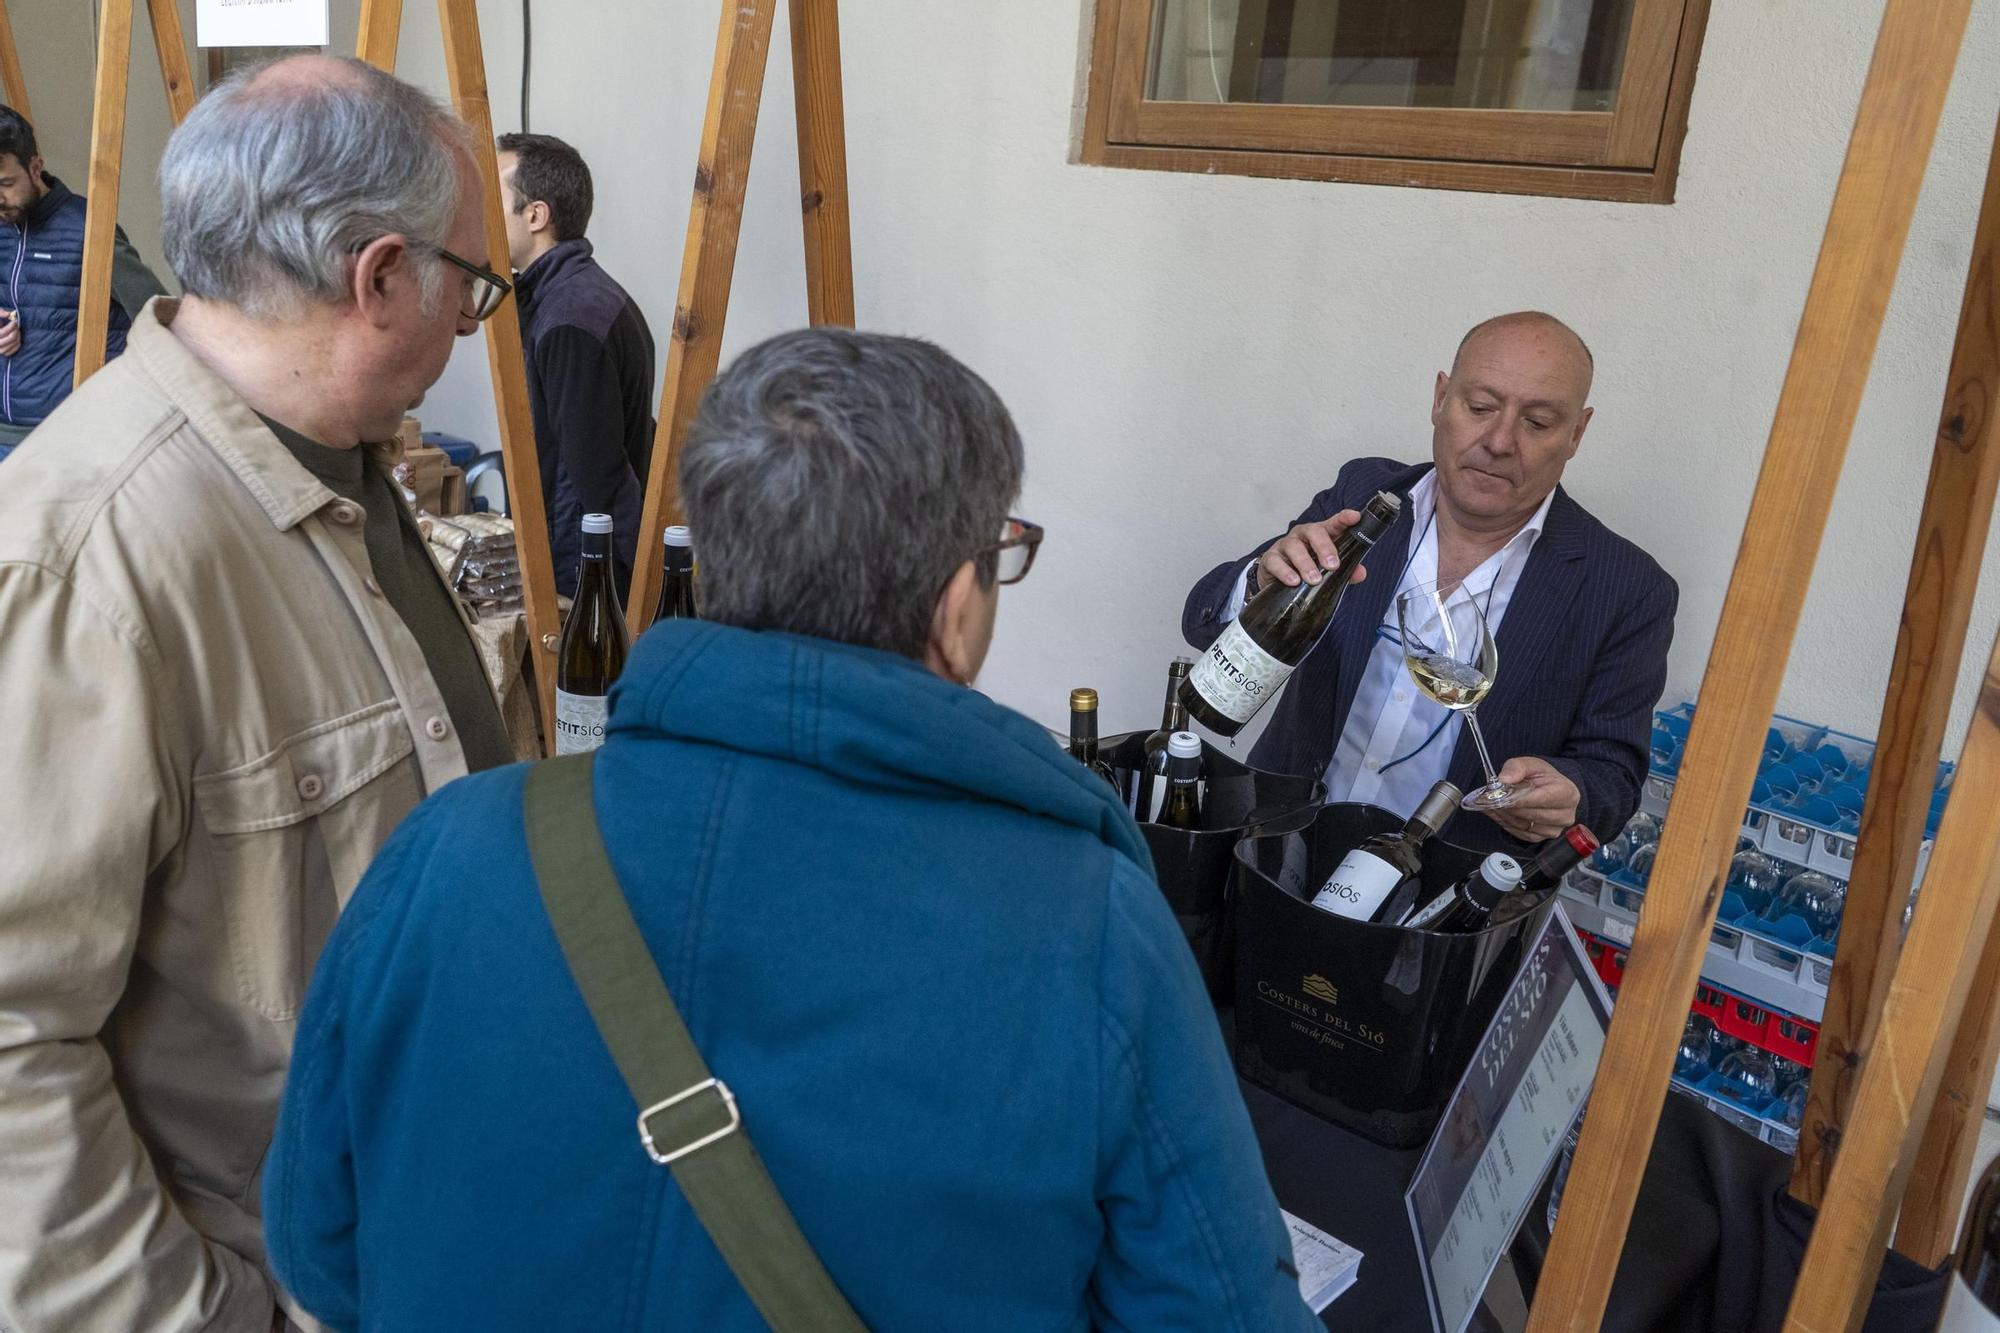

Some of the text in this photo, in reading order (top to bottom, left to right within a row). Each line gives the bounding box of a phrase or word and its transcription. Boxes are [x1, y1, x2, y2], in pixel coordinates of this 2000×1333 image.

[1211, 643, 1264, 695] PETITSIÓS
[557, 718, 604, 737] ETITSIÓ
[1481, 942, 1551, 1070] COSTERS
[1309, 1028, 1321, 1039] de
[1319, 1032, 1345, 1051] finca
[1488, 1032, 1519, 1090] DEL
